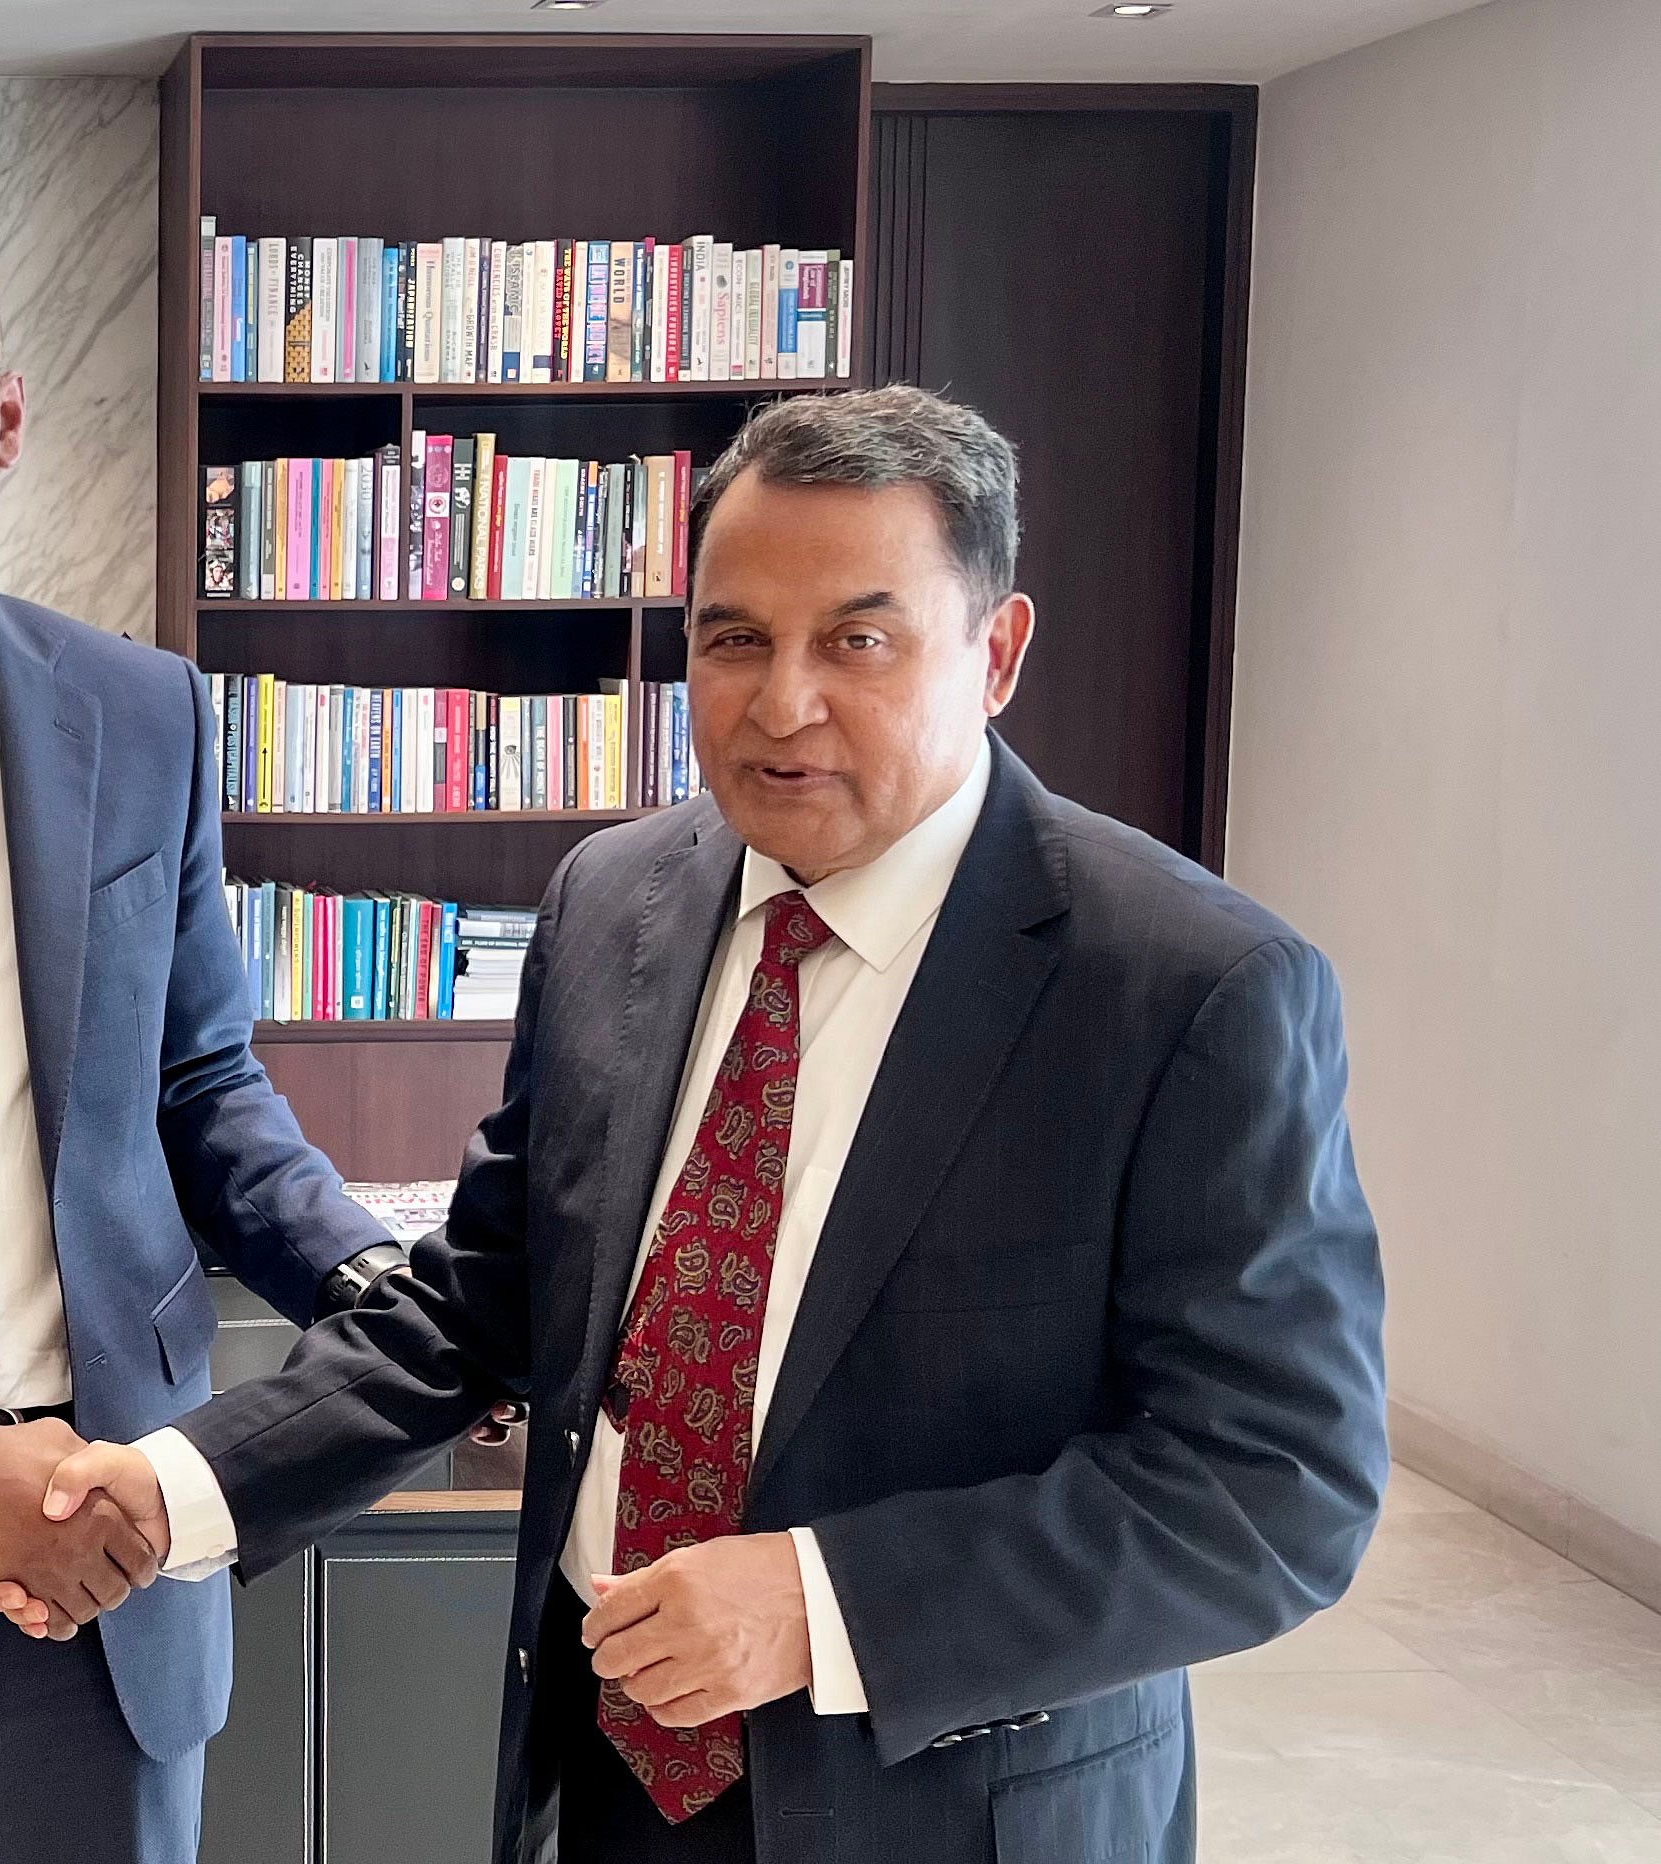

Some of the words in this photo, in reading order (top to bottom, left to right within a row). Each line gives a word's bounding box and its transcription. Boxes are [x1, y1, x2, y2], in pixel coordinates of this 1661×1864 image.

[268, 243, 279, 269] LORDS
[492, 248, 502, 297] CURRENCIES
[696, 241, 706, 271] INDIA
[268, 278, 279, 316] FINANCE
[509, 262, 521, 311] ISLAMIC
[613, 257, 625, 304] WORLD
[406, 278, 416, 348] JAPANIZATION
[465, 314, 475, 347] GROWTH
[714, 292, 729, 345] Sapiens
[490, 325, 499, 351] CRASH
[361, 465, 372, 501] 2030
[477, 481, 490, 545] NATIONAL
[475, 546, 487, 589] PARKS
[418, 972, 427, 1002] POWER
